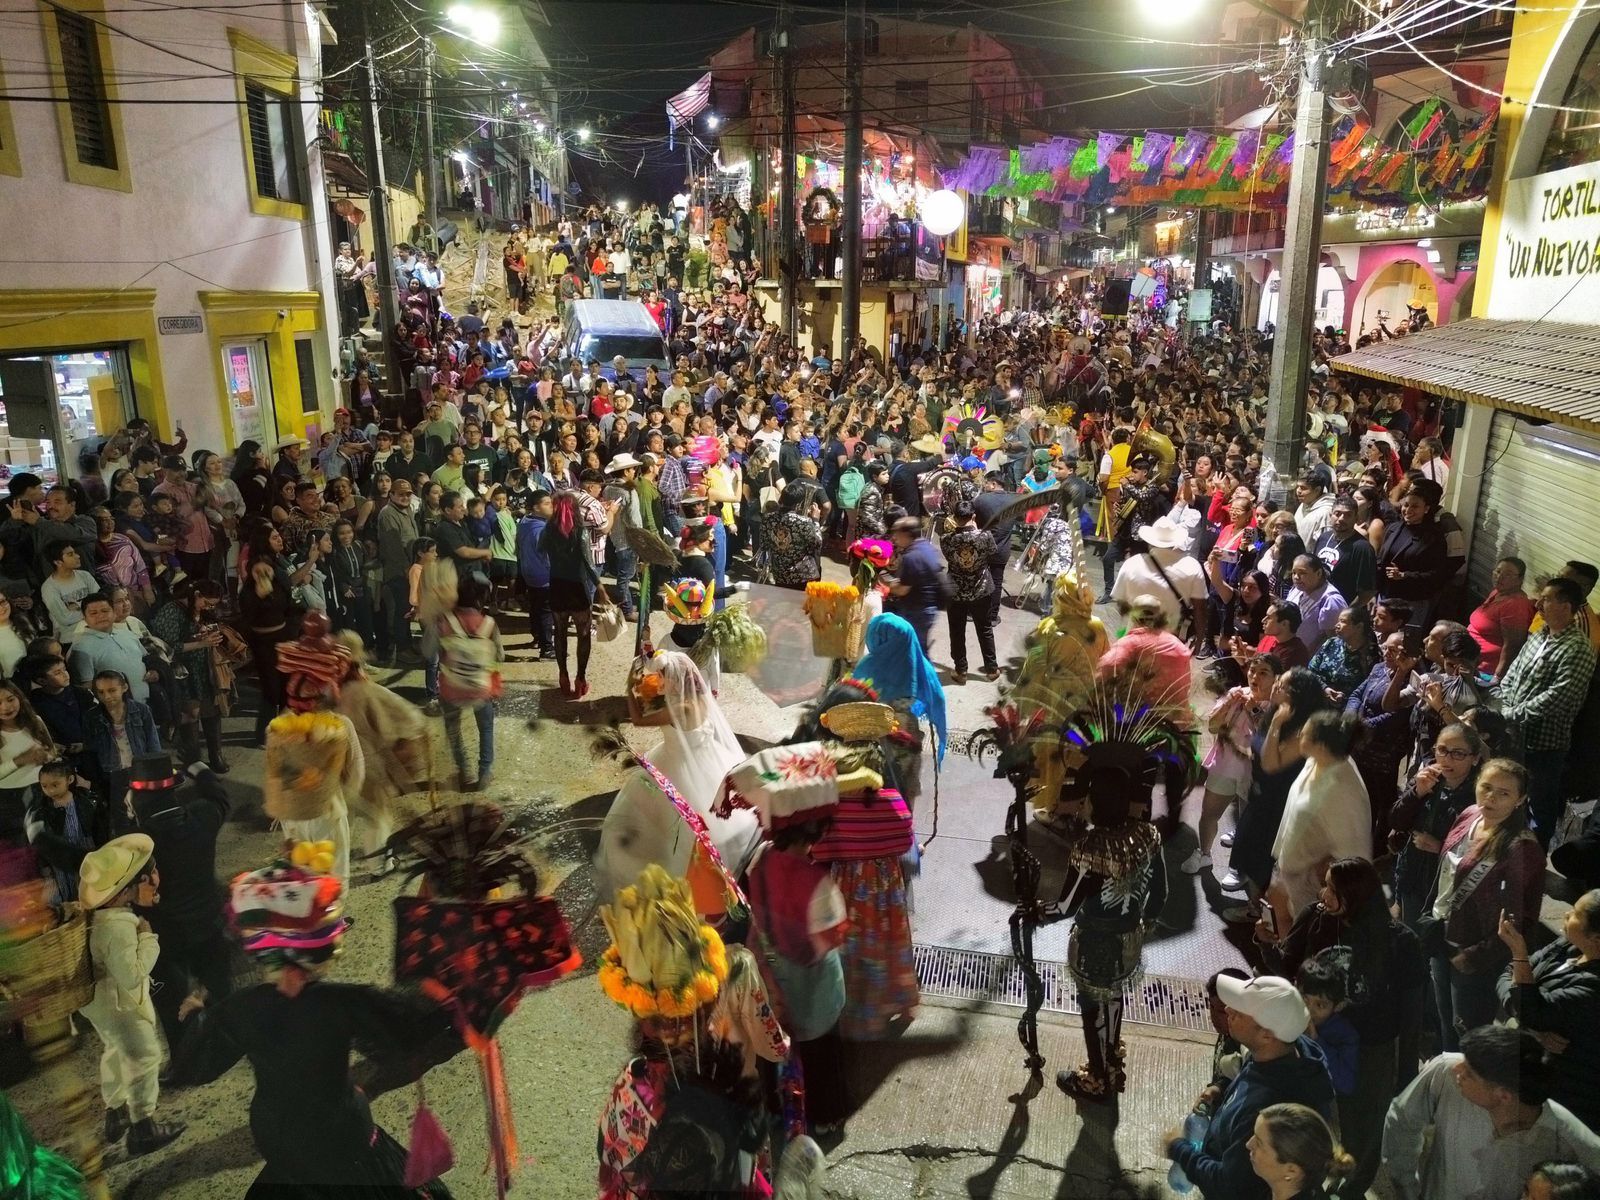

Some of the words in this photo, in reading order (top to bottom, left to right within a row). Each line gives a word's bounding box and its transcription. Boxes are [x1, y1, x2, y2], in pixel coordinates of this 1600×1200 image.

[1542, 179, 1600, 222] TORTIL
[1531, 237, 1589, 278] NUEVO
[162, 319, 199, 330] CORREGIDORA
[1469, 864, 1489, 884] LOLA
